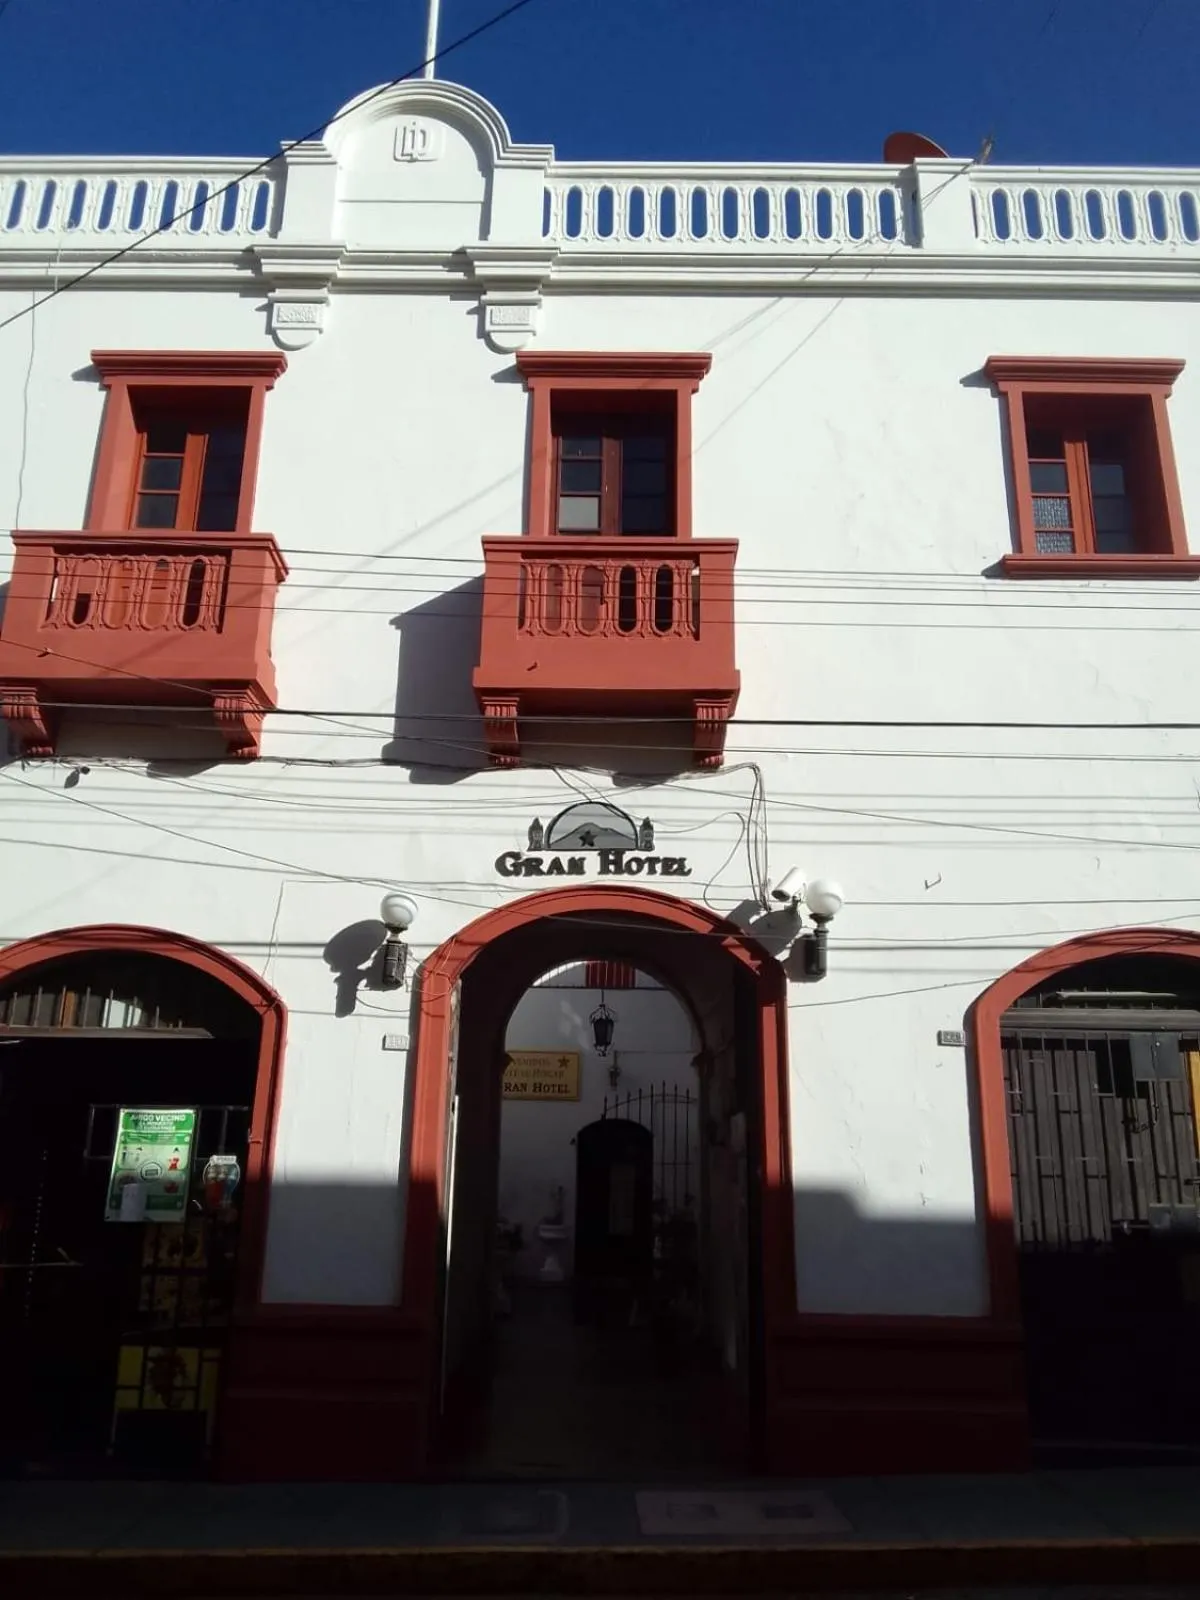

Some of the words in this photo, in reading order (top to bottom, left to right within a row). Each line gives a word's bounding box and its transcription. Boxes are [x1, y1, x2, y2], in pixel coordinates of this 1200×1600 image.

[495, 851, 587, 877] GRAN
[598, 850, 692, 877] HOTEL
[504, 1082, 528, 1093] RAN
[532, 1082, 571, 1094] HOTEL
